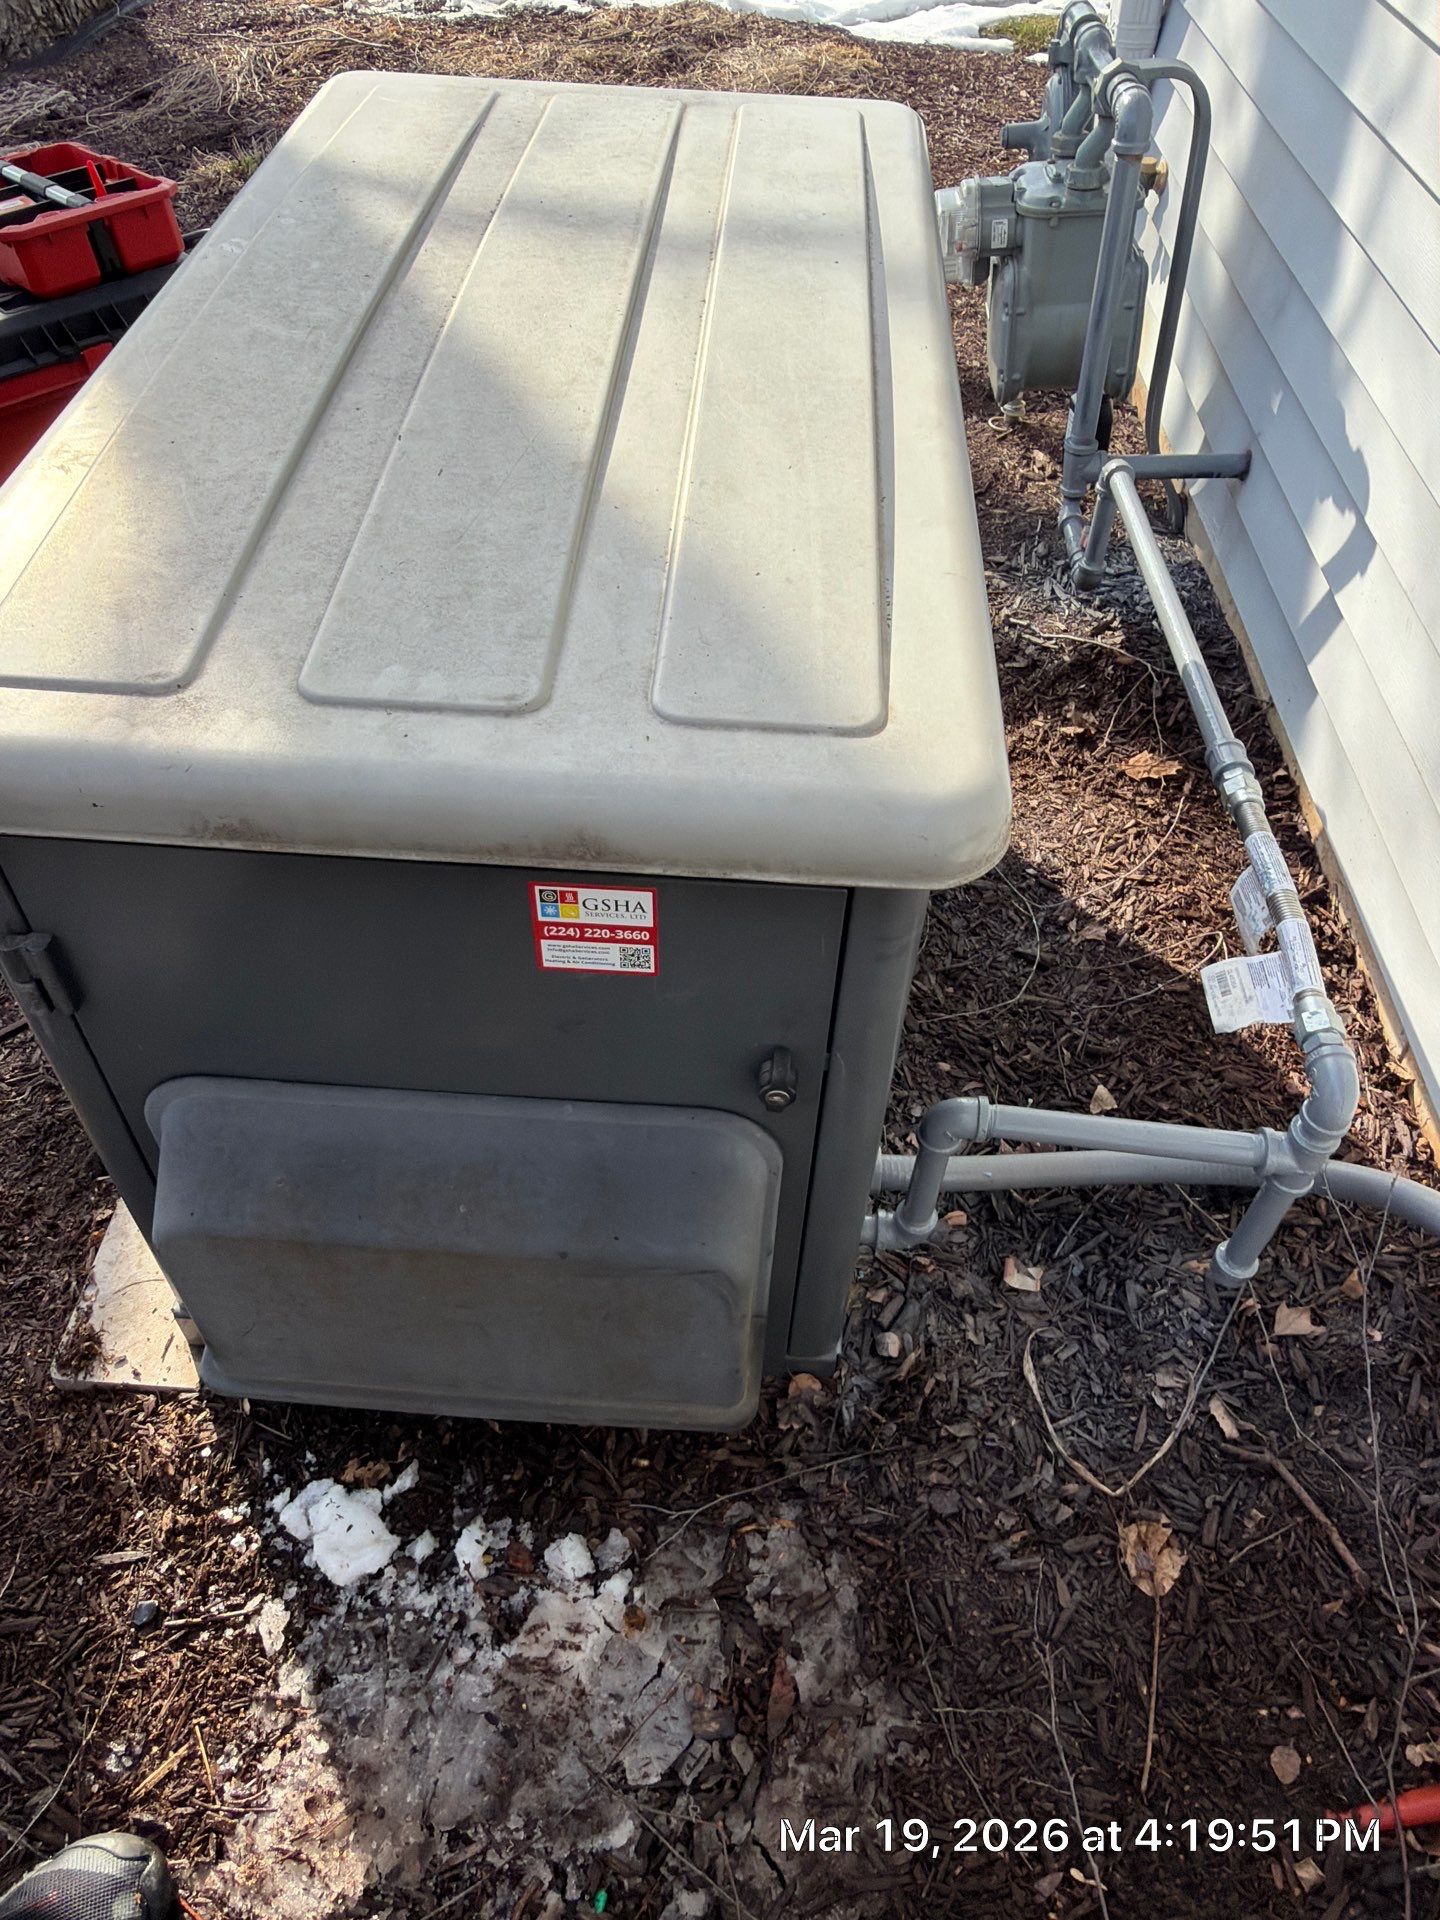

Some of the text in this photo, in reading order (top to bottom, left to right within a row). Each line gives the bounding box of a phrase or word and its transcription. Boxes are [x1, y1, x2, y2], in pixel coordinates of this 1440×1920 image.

[582, 898, 647, 913] GSHA
[543, 926, 650, 941] (224) 220-3660
